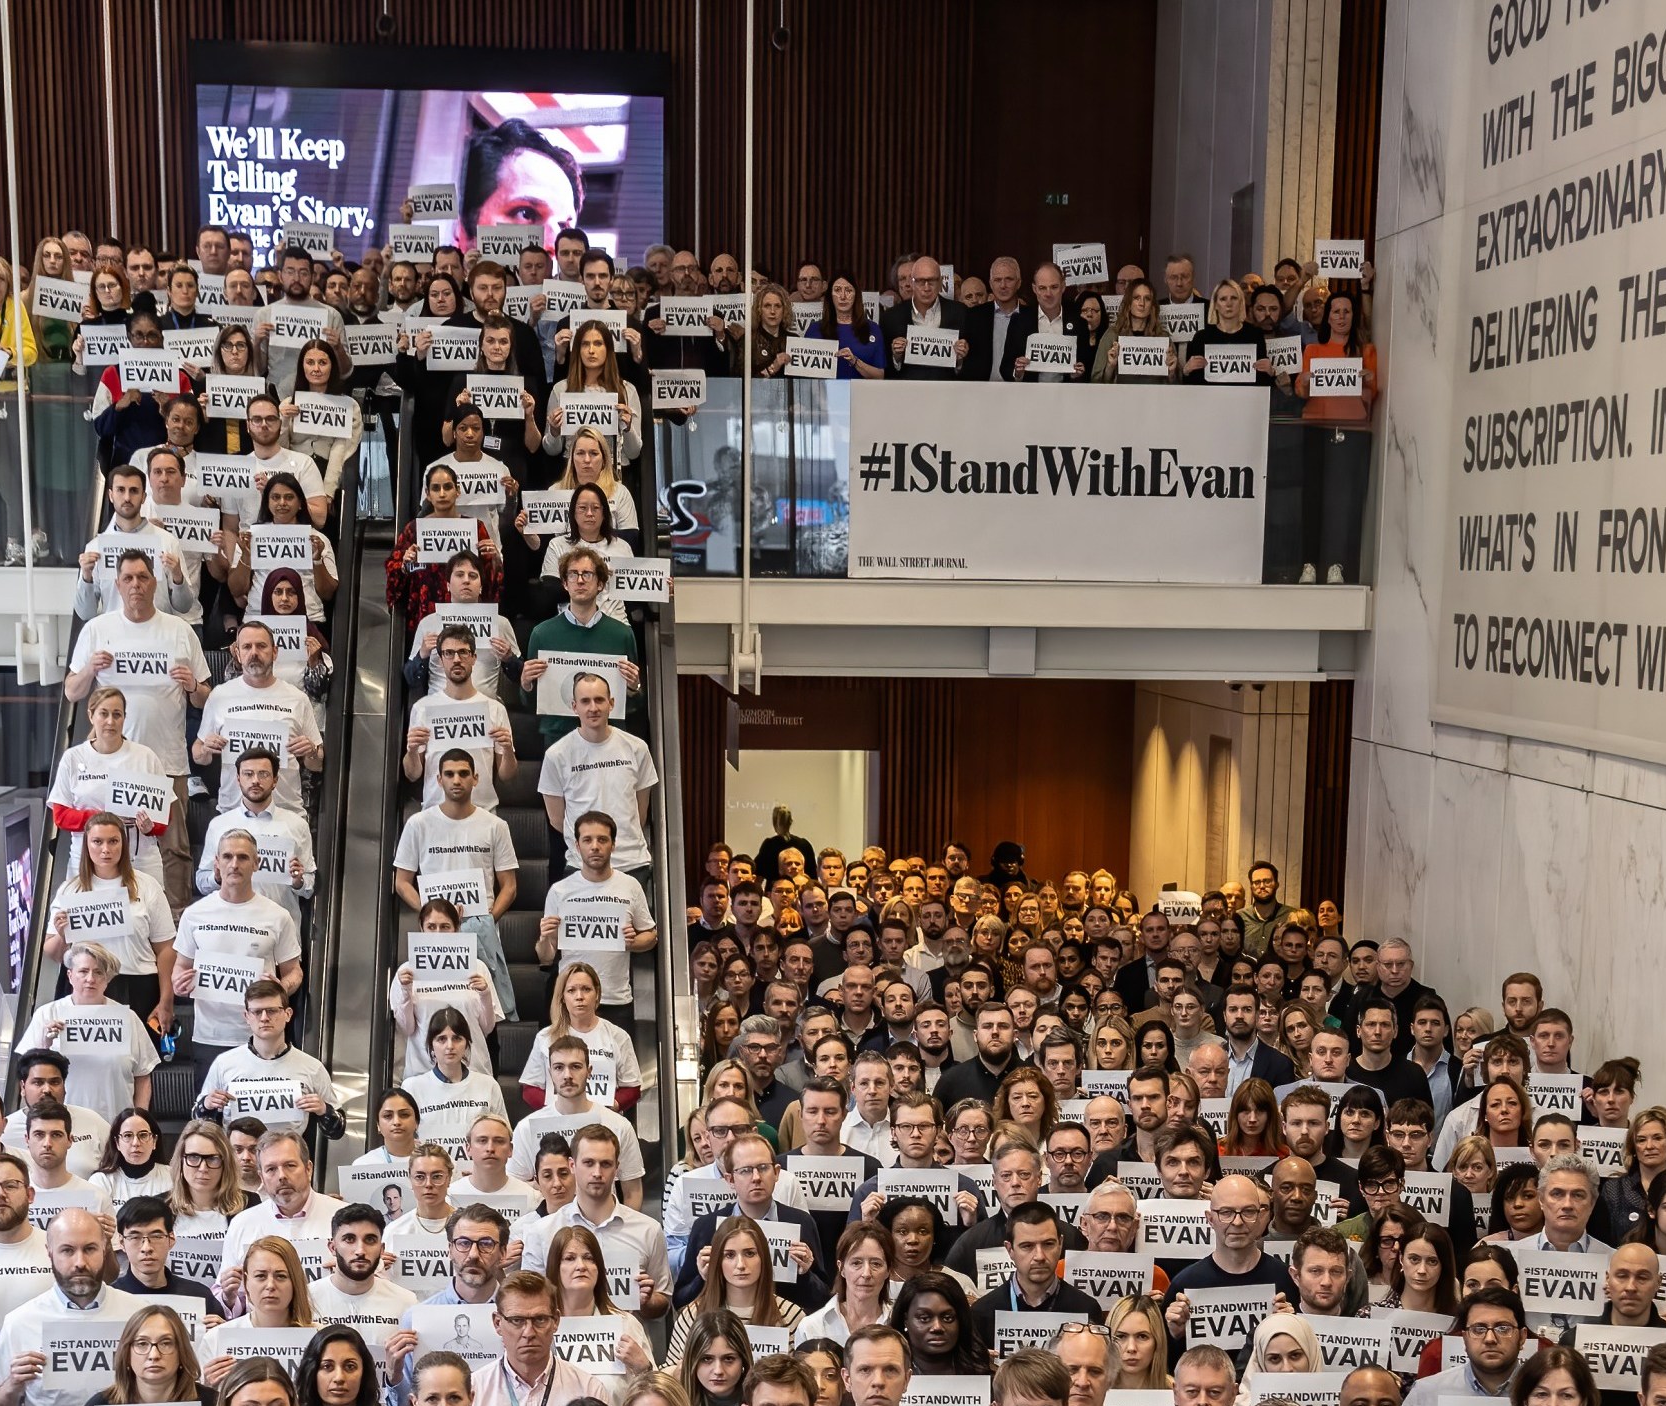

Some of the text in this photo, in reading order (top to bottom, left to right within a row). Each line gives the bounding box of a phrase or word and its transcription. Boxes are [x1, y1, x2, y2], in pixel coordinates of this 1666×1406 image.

[1488, 0, 1551, 65] GOOD
[1483, 90, 1535, 169] WITH
[1552, 61, 1596, 140] THE
[205, 126, 346, 170] We'll Keep
[207, 160, 298, 201] Telling
[208, 193, 375, 236] Evan's Story.
[1321, 256, 1361, 271] EVAN
[1469, 286, 1598, 373] DELIVERING
[910, 343, 951, 357] EVAN
[124, 360, 173, 368] #ISTANDWITH
[125, 368, 172, 382] EVAN
[1463, 393, 1632, 473] SUBSCRIPTION.
[860, 442, 1255, 499] #IStandWithEvan
[1460, 512, 1536, 571] WHAT'S
[1554, 511, 1578, 572] IN
[858, 556, 874, 567] THE
[876, 556, 898, 567] WALL
[899, 557, 930, 568] STREET
[113, 652, 168, 660] #ISTANDWITH
[1454, 613, 1479, 670] TO
[1486, 616, 1628, 687] RECONNECT
[116, 659, 167, 674] EVAN
[547, 657, 619, 669] #IStandWithEvan
[564, 915, 619, 923] #ISTANDWITH
[565, 923, 618, 939] EVAN
[415, 954, 469, 970] EVAN
[64, 1018, 123, 1026] #ISTANDWITH
[66, 1027, 122, 1042] EVAN
